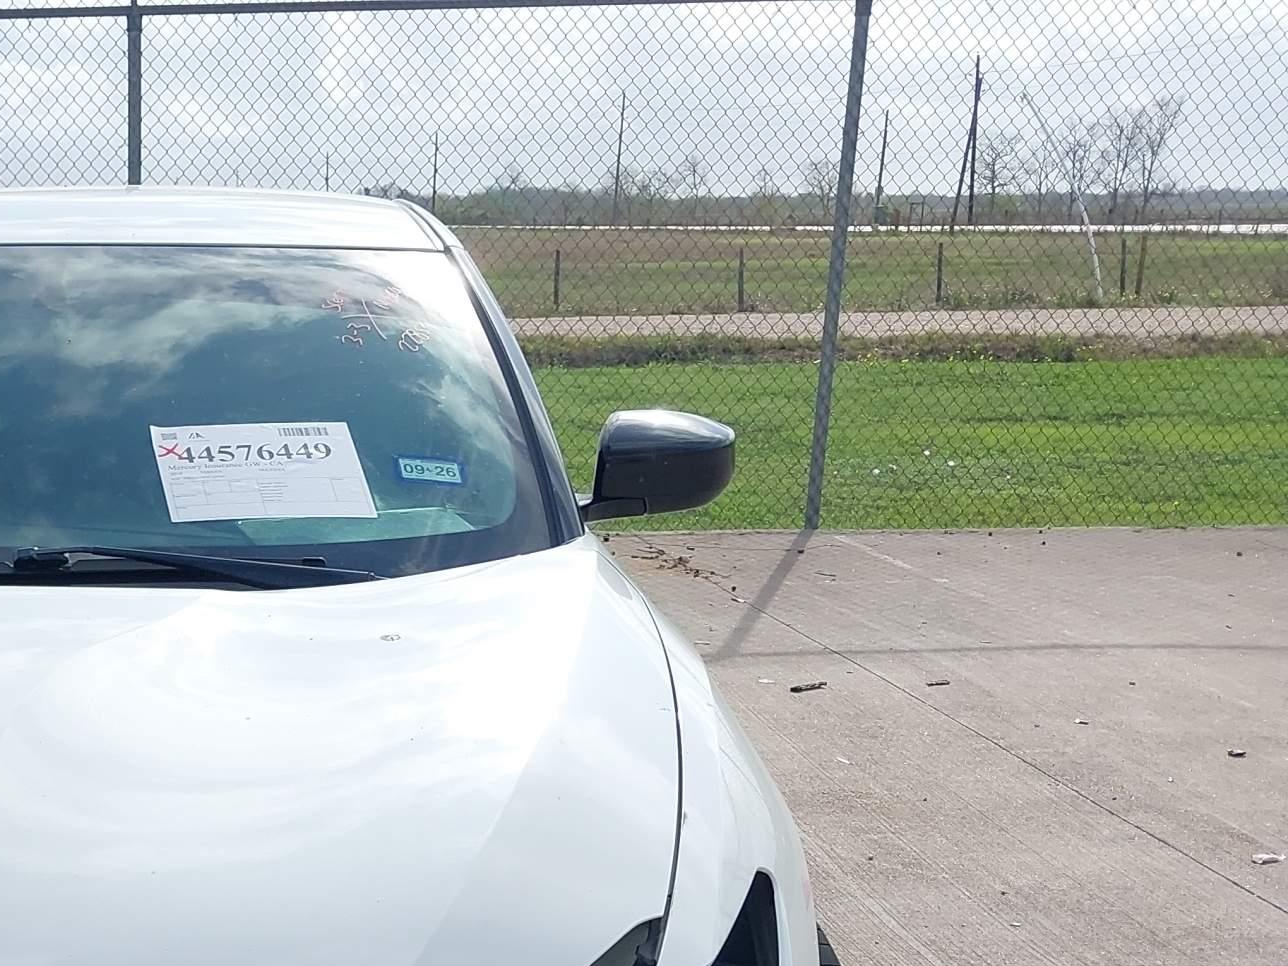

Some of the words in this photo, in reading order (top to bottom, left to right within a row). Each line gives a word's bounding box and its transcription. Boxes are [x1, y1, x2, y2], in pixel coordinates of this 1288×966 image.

[177, 442, 332, 464] 44576449
[167, 463, 202, 472] Mercury
[203, 462, 243, 471] Insurance
[403, 463, 425, 475] 09
[434, 465, 457, 478] 26
